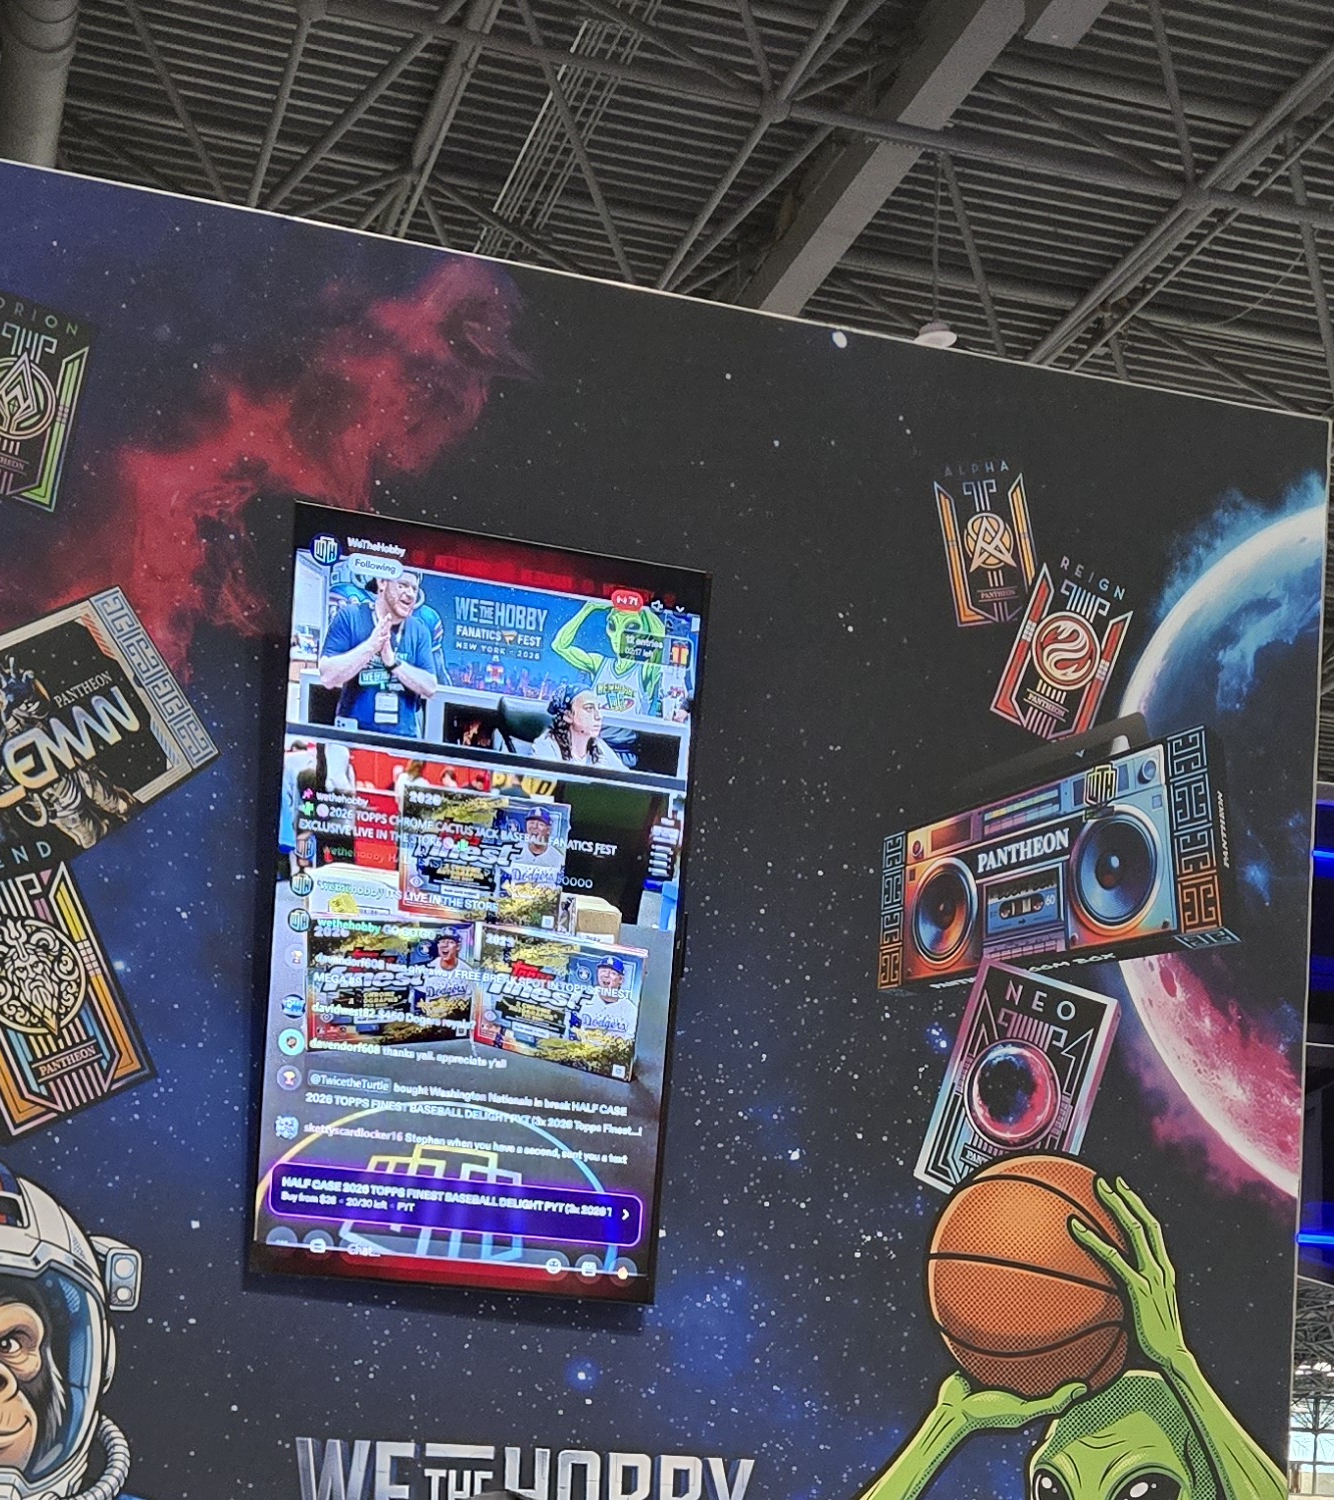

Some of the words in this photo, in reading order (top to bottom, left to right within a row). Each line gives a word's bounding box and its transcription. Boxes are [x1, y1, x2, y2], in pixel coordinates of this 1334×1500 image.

[944, 459, 1010, 477] ALPHA
[354, 558, 397, 575] Following
[1059, 555, 1126, 601] REIGN
[455, 595, 479, 623] WE
[478, 605, 495, 620] THE
[495, 602, 548, 632] HOBBY
[455, 624, 502, 642] FANATICS
[517, 633, 542, 648] FEST
[481, 644, 506, 655] YORK
[53, 670, 113, 709] PANTHEON
[1026, 692, 1066, 718] PANTHEON
[298, 818, 352, 836] EXCLUSIVE
[353, 826, 374, 838] LIVE
[375, 829, 388, 840] IN
[389, 831, 409, 843] THE
[330, 806, 354, 818] 2026
[356, 810, 388, 825] TOPPS
[389, 814, 433, 830] CHROME
[501, 831, 548, 846] BASEBALL
[548, 837, 594, 853] FANATICS
[593, 843, 618, 857] FEST
[977, 827, 1070, 874] PANTHEON
[405, 890, 428, 904] LIVE
[428, 894, 442, 906] IN
[441, 896, 464, 908] THE
[464, 898, 499, 913] STORE
[317, 918, 383, 936] wethehobby
[454, 969, 482, 982] FREE
[1004, 979, 1077, 1022] NEO
[581, 1012, 630, 1033] Dodgers
[38, 1043, 98, 1078] PANTHEON
[333, 1094, 371, 1109] TOPPS
[370, 1099, 409, 1113] FINEST
[409, 1102, 465, 1119] BASEBALL
[393, 1081, 430, 1097] bought
[571, 1100, 599, 1115] HALF
[599, 1104, 629, 1118] CASE
[965, 1150, 990, 1165] PANT
[281, 1175, 312, 1190] HALF
[312, 1179, 342, 1192] CASE
[370, 1184, 406, 1199] TOPPS
[406, 1187, 445, 1202] FINEST
[445, 1191, 499, 1207] BASEBALL
